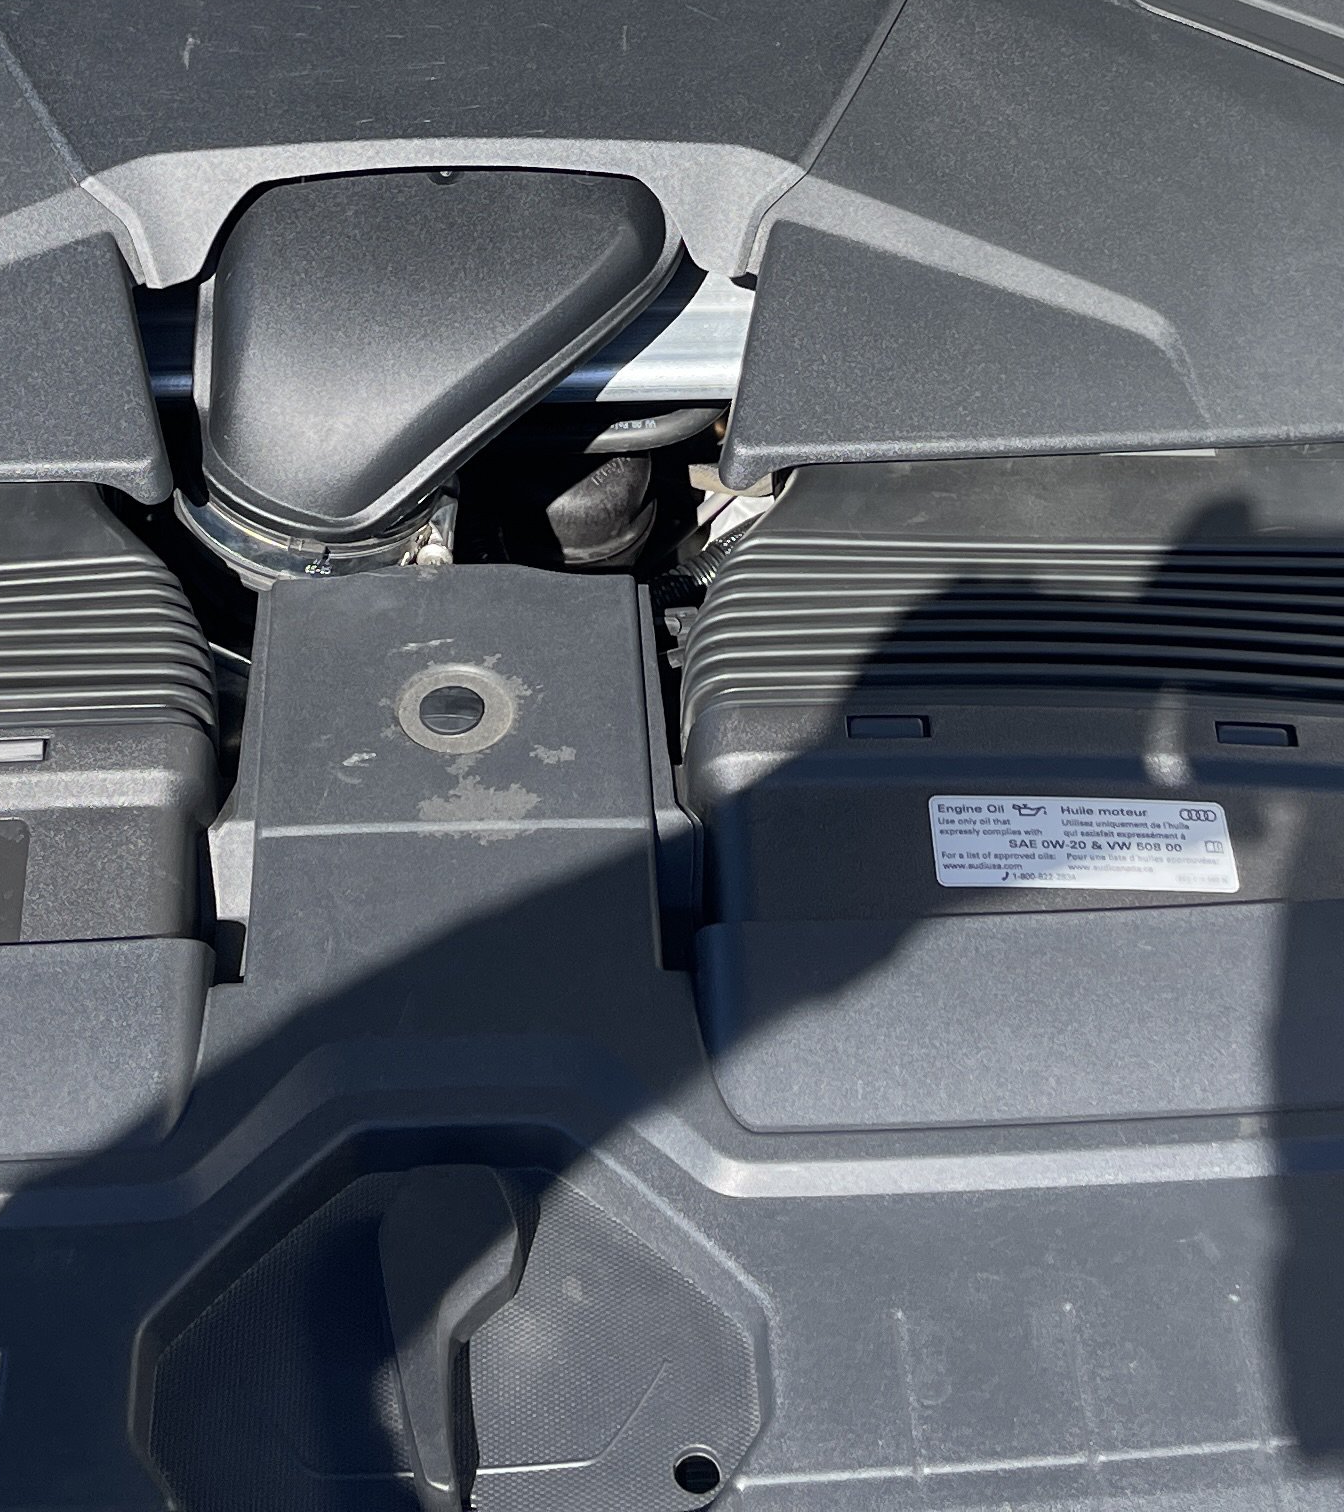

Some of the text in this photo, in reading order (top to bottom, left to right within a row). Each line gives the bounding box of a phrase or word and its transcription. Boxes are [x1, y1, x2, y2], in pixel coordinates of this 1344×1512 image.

[938, 804, 1004, 814] Engine Oil
[1061, 806, 1148, 817] Huile moteur
[958, 818, 976, 826] only
[1096, 821, 1149, 829] uniquement
[940, 828, 980, 837] expressly
[983, 829, 1022, 837] complies
[1064, 830, 1078, 838] qui
[1009, 840, 1038, 848] SAE
[1042, 840, 1087, 849] 0W-20
[1091, 842, 1103, 850] &
[1106, 842, 1131, 850] VW
[1166, 843, 1183, 851] 00
[994, 852, 1036, 861] approved
[1038, 852, 1056, 860] oils:
[1067, 853, 1087, 861] Pour
